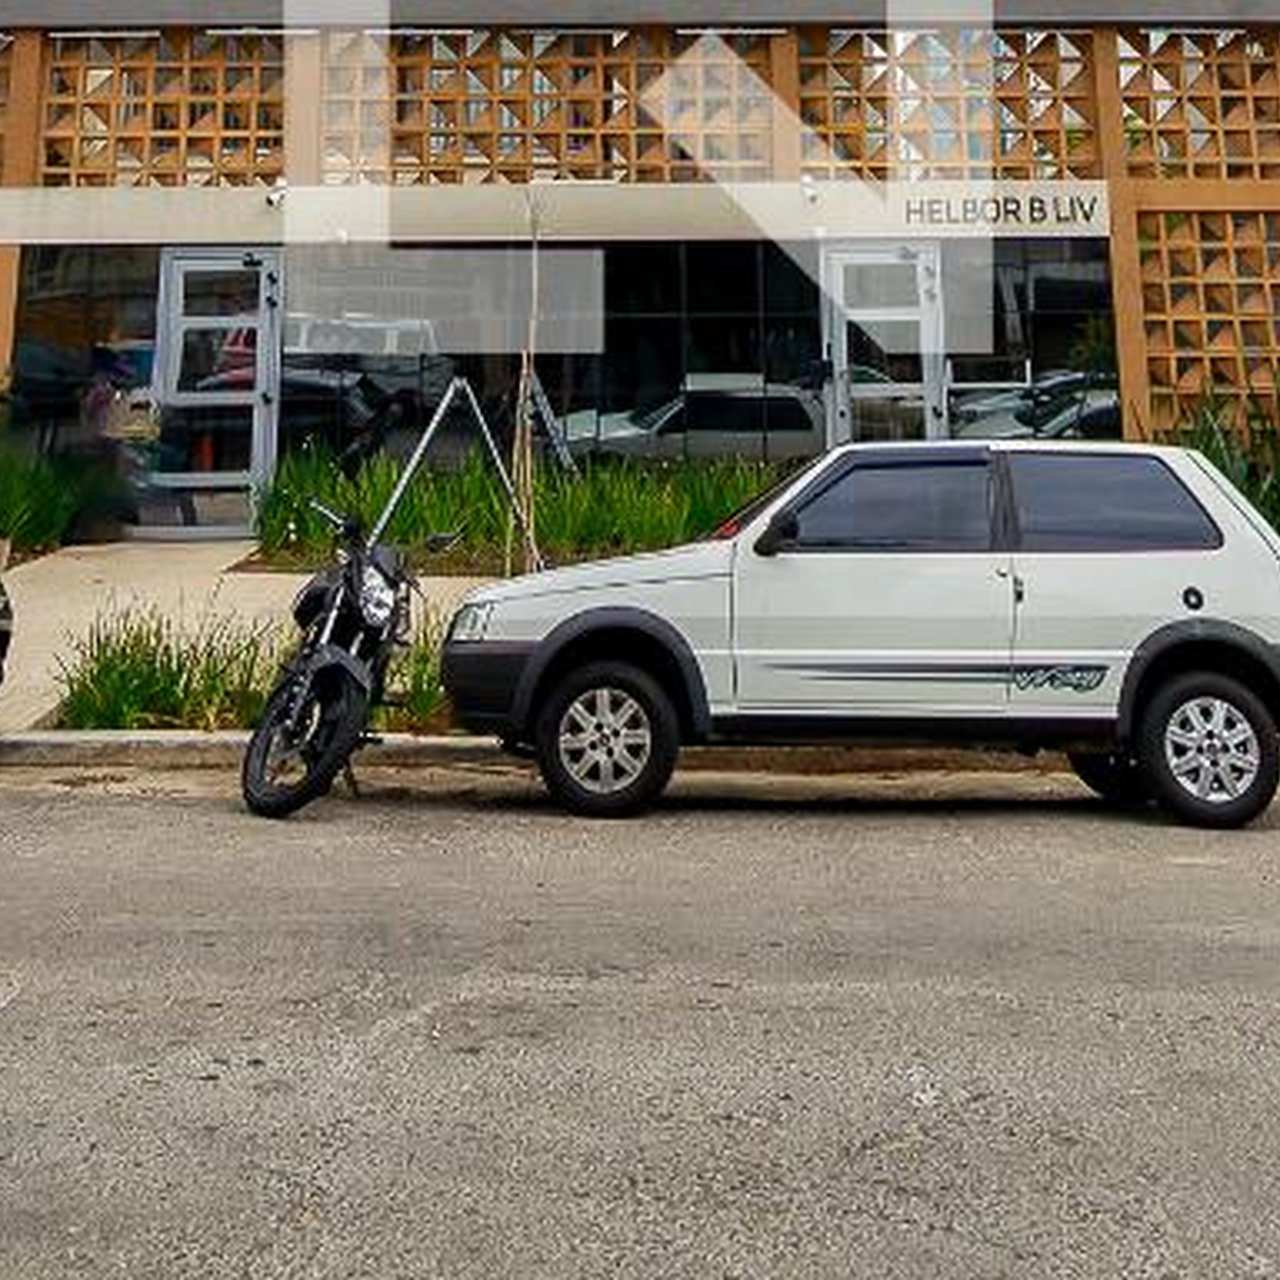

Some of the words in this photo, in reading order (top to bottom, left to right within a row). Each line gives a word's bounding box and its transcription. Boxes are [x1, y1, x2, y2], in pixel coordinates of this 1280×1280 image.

[905, 195, 1021, 223] HELBOR
[1028, 195, 1048, 223] B
[1053, 195, 1099, 223] LIV
